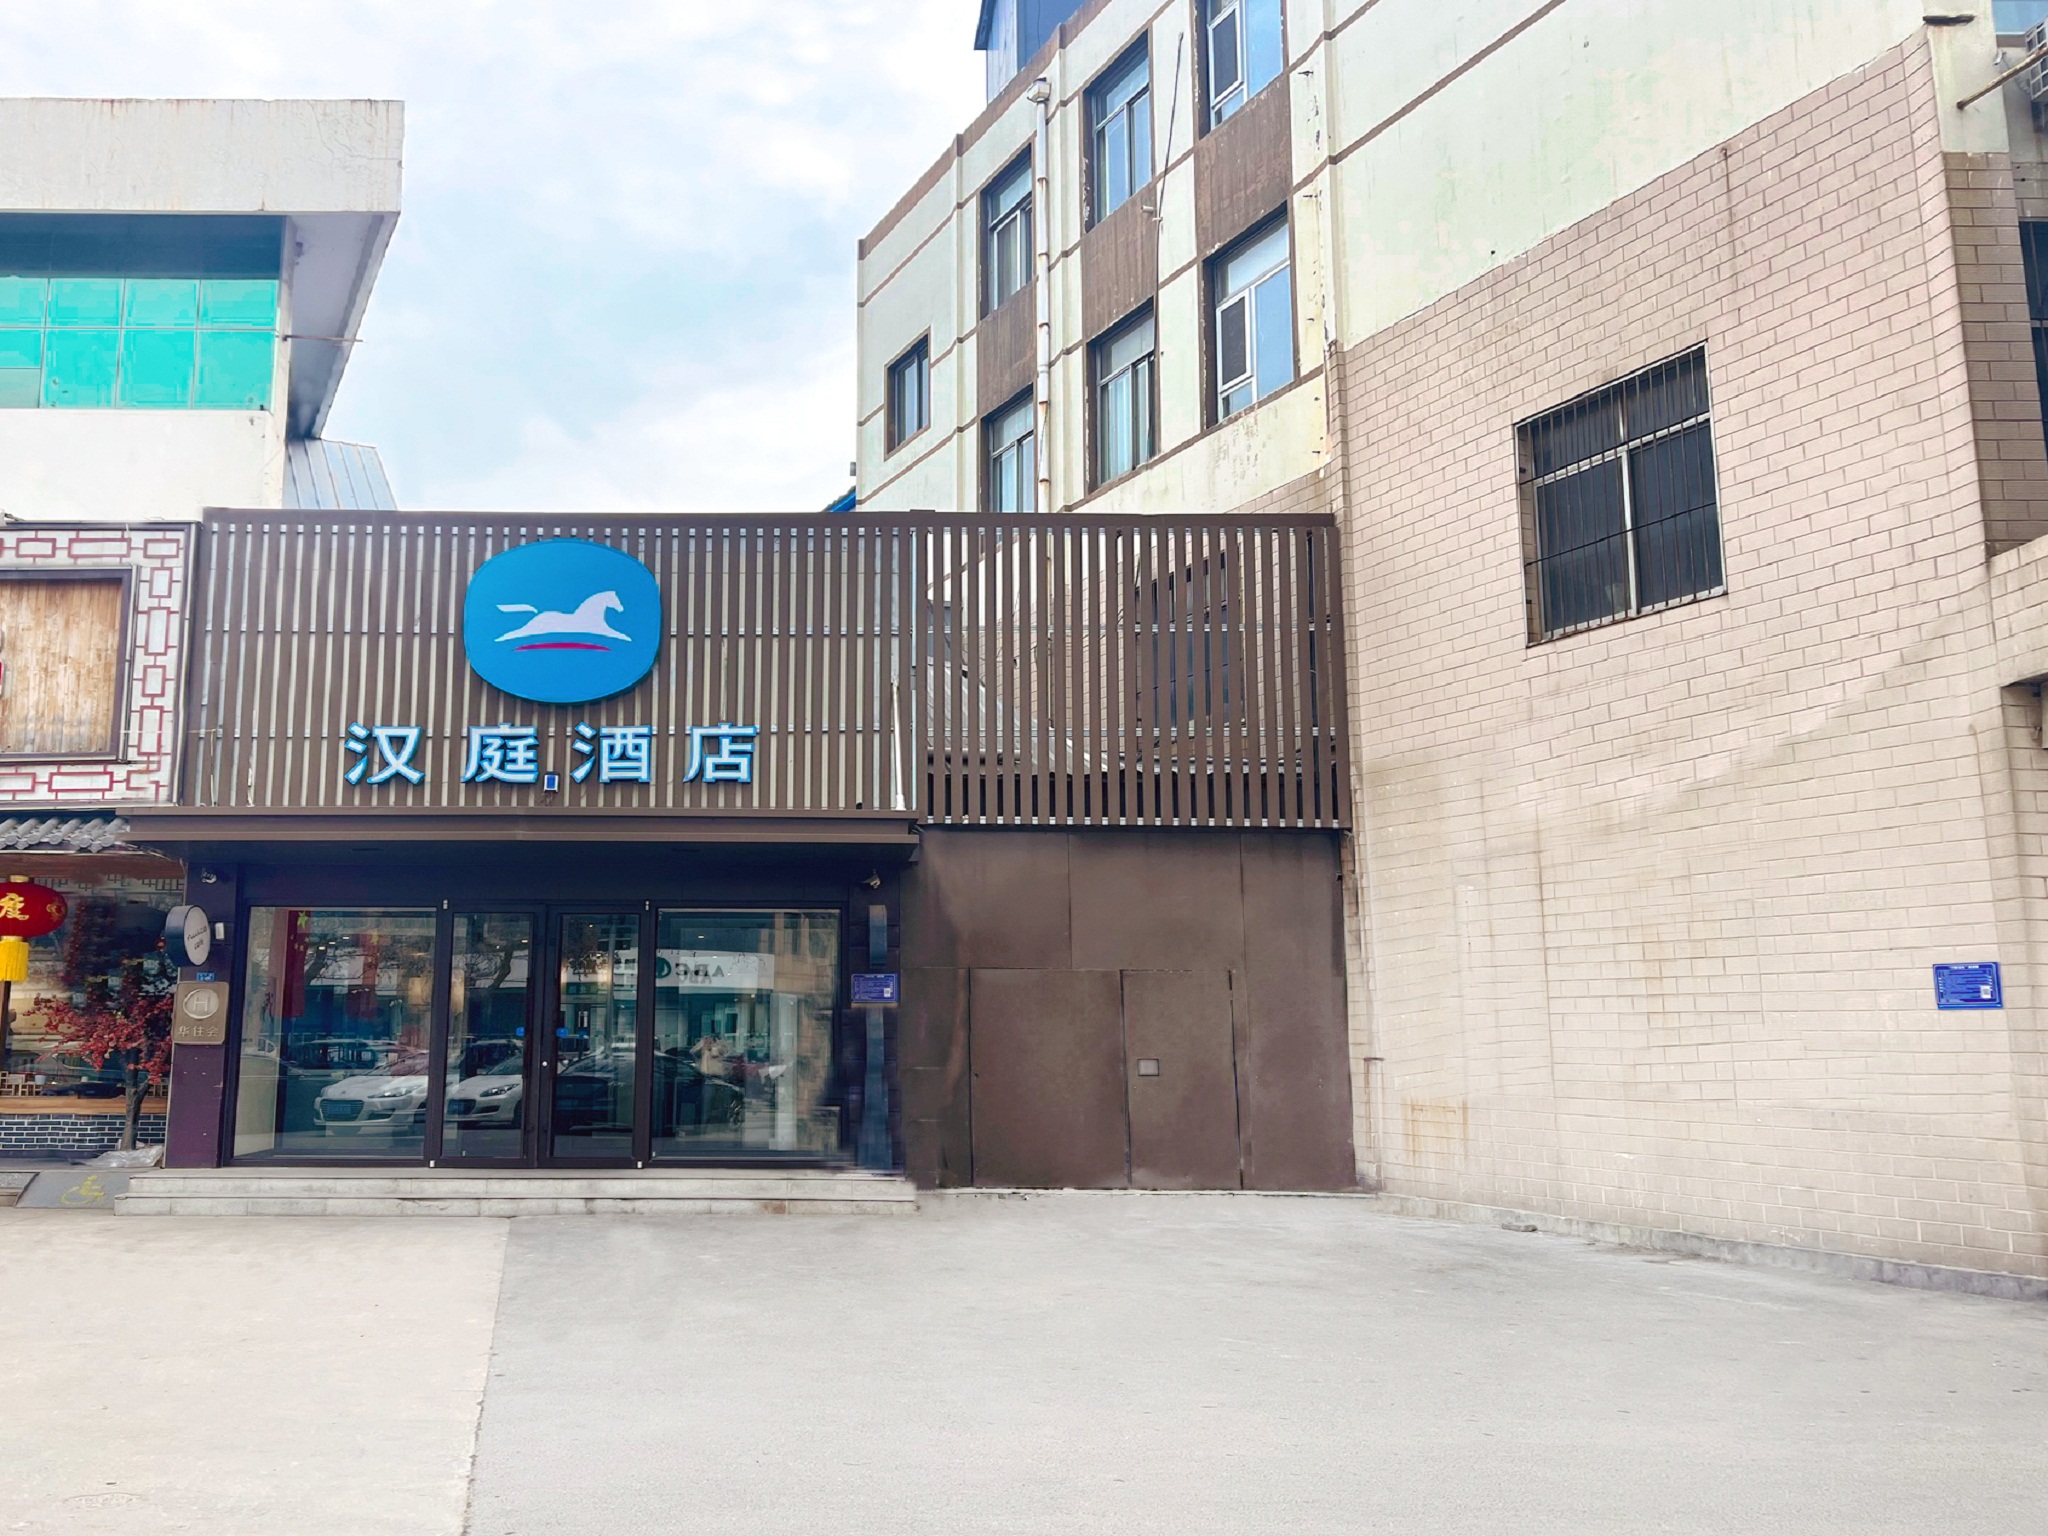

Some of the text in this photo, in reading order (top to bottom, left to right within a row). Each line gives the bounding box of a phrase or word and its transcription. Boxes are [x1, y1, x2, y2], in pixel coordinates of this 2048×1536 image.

[344, 722, 759, 785] 汉庭酒店
[179, 1026, 219, 1037] 华住会
